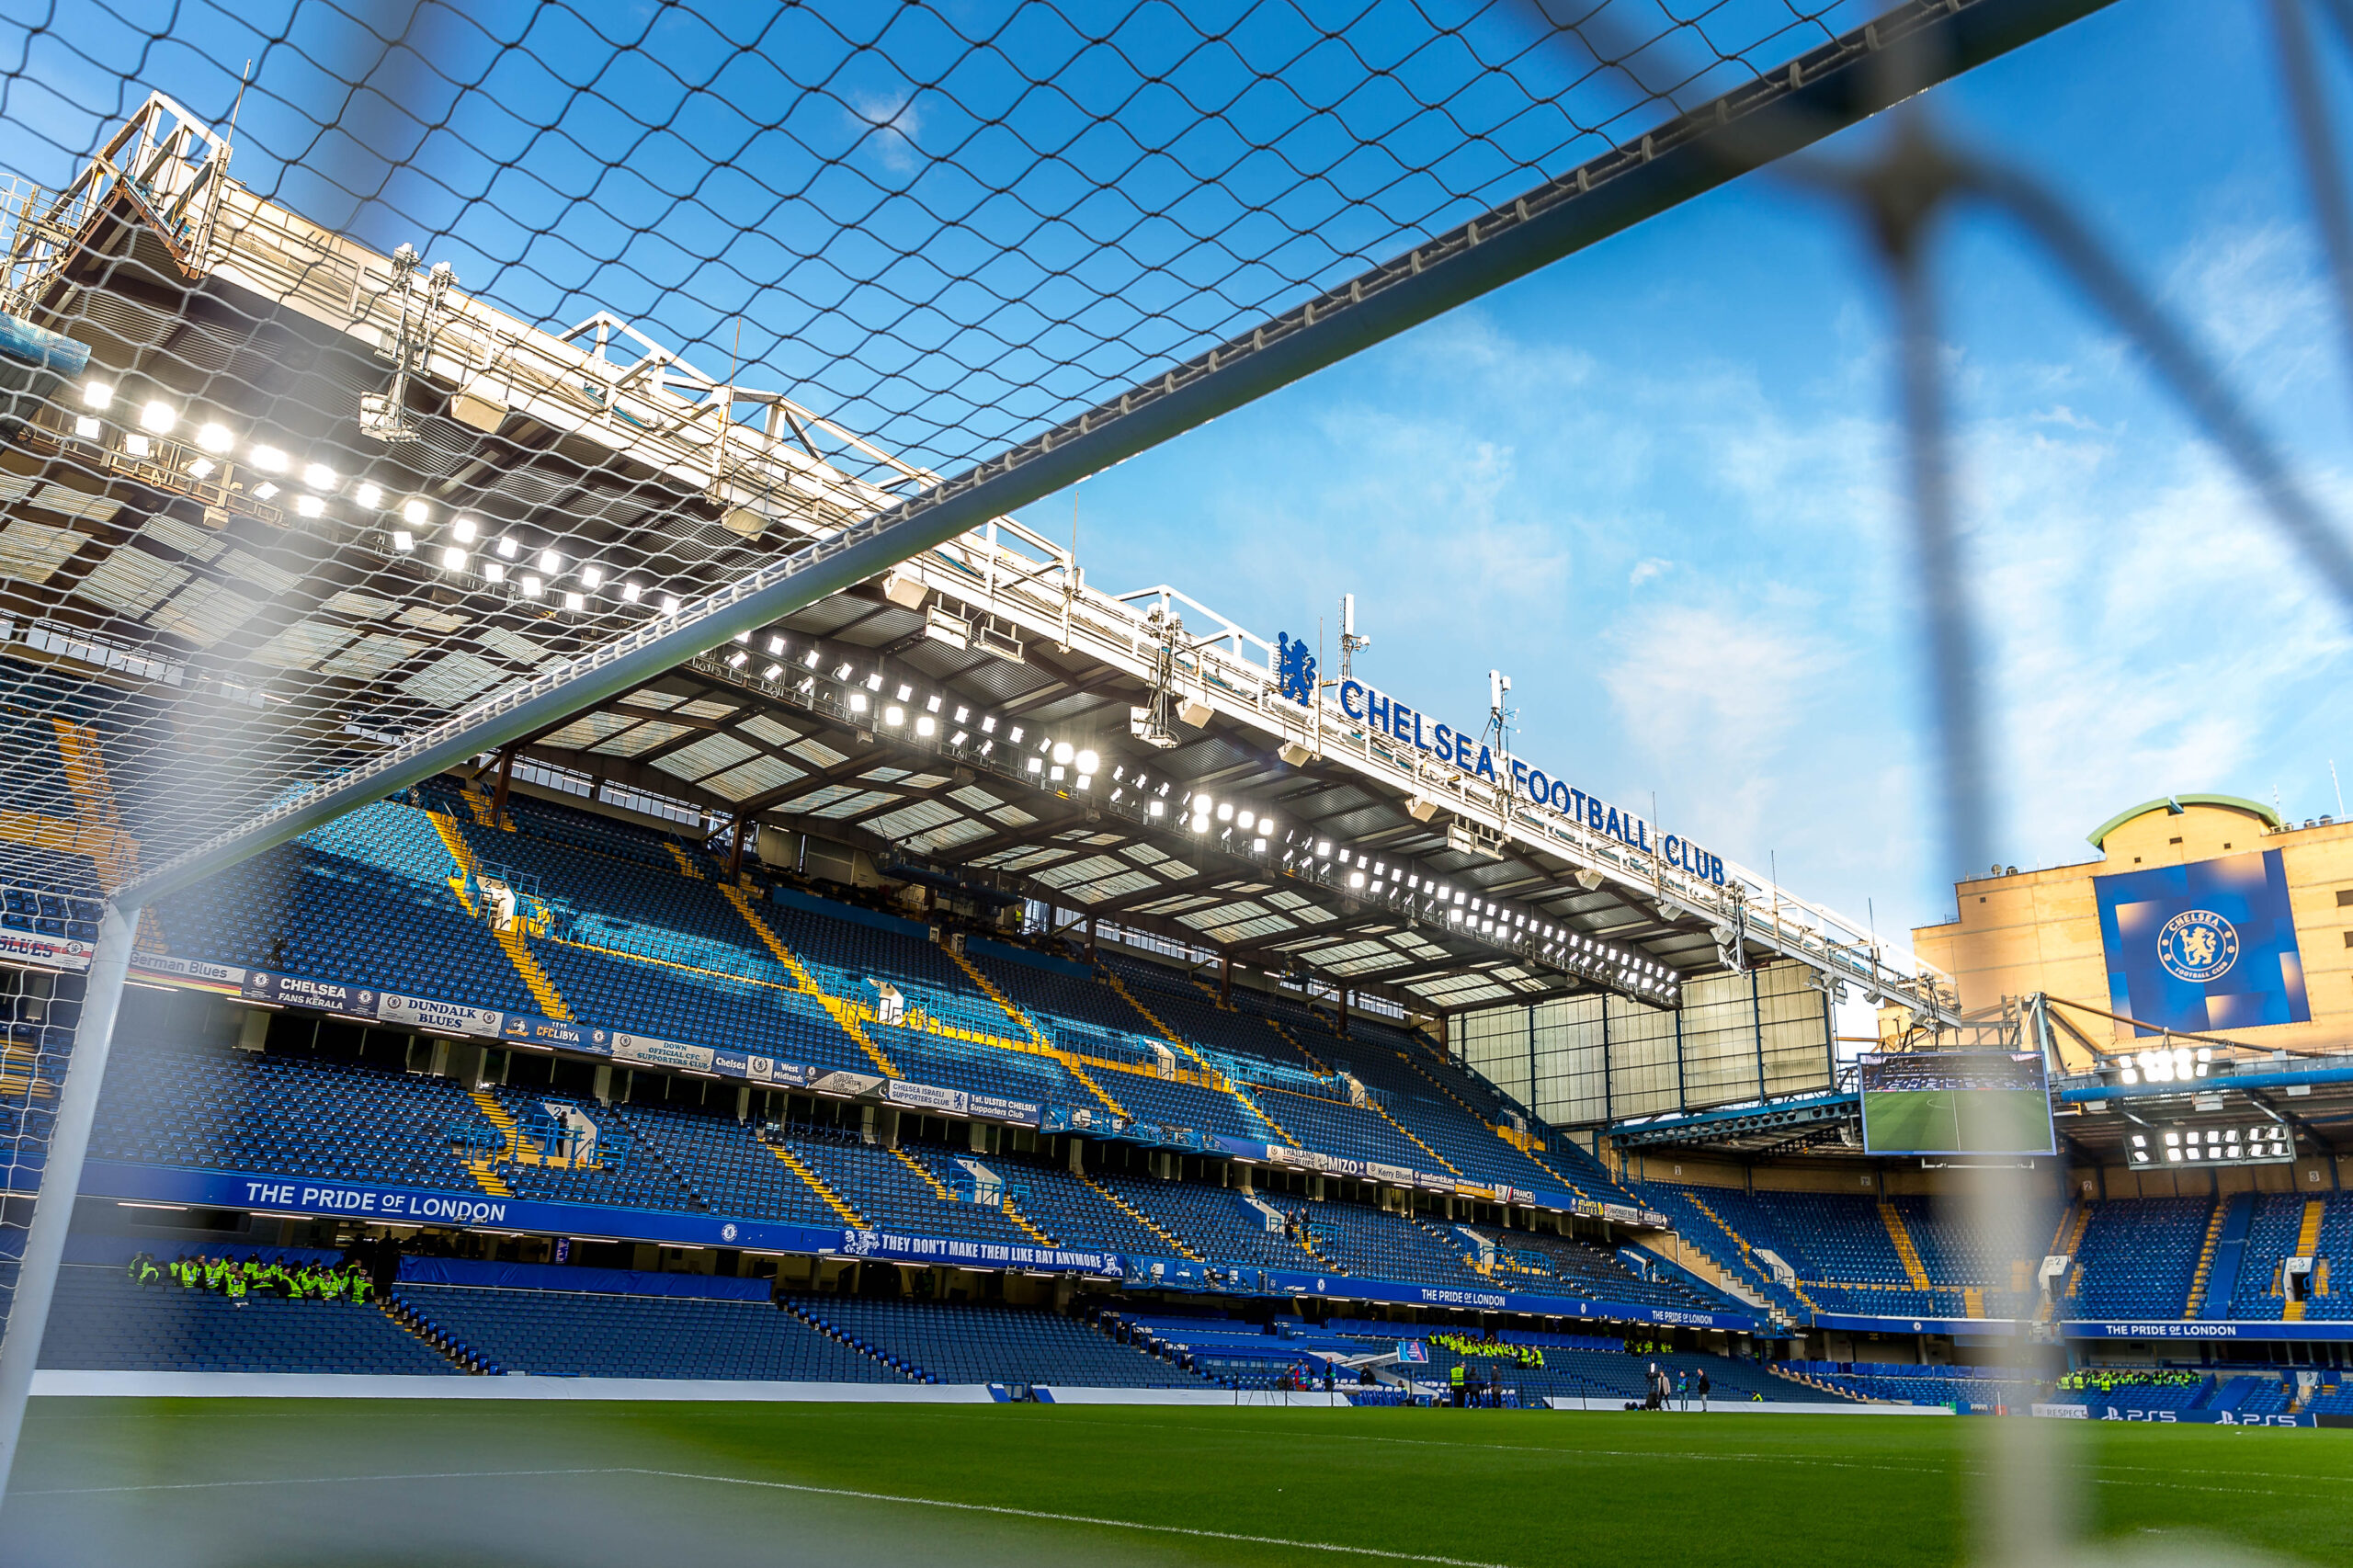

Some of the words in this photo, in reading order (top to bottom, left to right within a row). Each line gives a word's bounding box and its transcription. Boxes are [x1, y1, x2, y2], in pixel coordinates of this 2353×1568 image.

[1339, 679, 1496, 784] CHELSEA
[1511, 758, 1653, 854] FOOTBALL
[1664, 835, 1725, 887] CLUB
[484, 879, 493, 889] 2
[2168, 913, 2220, 932] CHELSEA
[130, 950, 185, 972] German
[188, 960, 228, 978] Blues
[2175, 967, 2210, 979] FOOTBALL
[2211, 960, 2228, 975] CLUB
[280, 978, 347, 999] CHELSEA
[278, 993, 304, 1005] FANS
[305, 997, 344, 1010] KERALA
[407, 999, 477, 1019] DUNDALK
[418, 1013, 462, 1028] BLUES
[536, 1026, 580, 1042] CFCLIBYA
[663, 1041, 688, 1051] DOWN
[637, 1052, 688, 1066] SUPPORTERS
[689, 1061, 708, 1070] CLUB
[648, 1047, 683, 1059] OFFICIAL
[685, 1052, 700, 1061] CFC
[715, 1057, 746, 1071] Chelsea
[780, 1062, 799, 1074] West
[773, 1071, 803, 1084] Midlands
[892, 1083, 921, 1095] CHELSEA
[922, 1087, 945, 1098] ISRAELI
[892, 1091, 932, 1105] SUPPORTERS
[933, 1096, 949, 1107] CLUB
[983, 1096, 1007, 1108] ULSTER
[1007, 1099, 1037, 1113] CHELSEA
[552, 1106, 562, 1118] 2
[970, 1104, 1006, 1118] Supporters
[1007, 1109, 1025, 1119] Club
[1282, 1147, 1315, 1160] THAILAND
[1328, 1156, 1358, 1175] MIZO
[1377, 1167, 1394, 1179] Kerry
[1395, 1170, 1412, 1181] Blues
[2310, 1172, 2318, 1181] 3
[1513, 1188, 1533, 1199] FRANCE
[245, 1182, 296, 1205] THE
[301, 1187, 377, 1211] PRIDE
[381, 1194, 405, 1210] OF
[409, 1197, 506, 1221] LONDON
[1578, 1199, 1597, 1208] ATLANTA
[1577, 1205, 1597, 1215] BLUES
[881, 1234, 910, 1252] THEY
[913, 1237, 947, 1256] DON'T
[949, 1240, 979, 1258] MAKE
[981, 1243, 1009, 1261] THEM
[1011, 1246, 1033, 1263] LIKE
[1035, 1249, 1054, 1265] RAY
[1056, 1251, 1102, 1268] ANYMORE
[2054, 1257, 2062, 1266] 2
[1421, 1289, 1438, 1302] THE
[1438, 1290, 1463, 1304] PRIDE
[1464, 1292, 1472, 1301] OF
[1472, 1293, 1506, 1307] LONDON
[1652, 1310, 1664, 1321] THE
[1664, 1311, 1682, 1324] PRIDE
[1688, 1313, 1713, 1325] LONDON
[2106, 1324, 2128, 1335] THE
[2131, 1325, 2166, 1335] PRIDE
[2169, 1326, 2181, 1335] OF
[2183, 1325, 2236, 1336] LONDON
[2046, 1408, 2086, 1418] RESPECT
[2127, 1409, 2177, 1424] PS5
[2242, 1414, 2298, 1428] PS5
